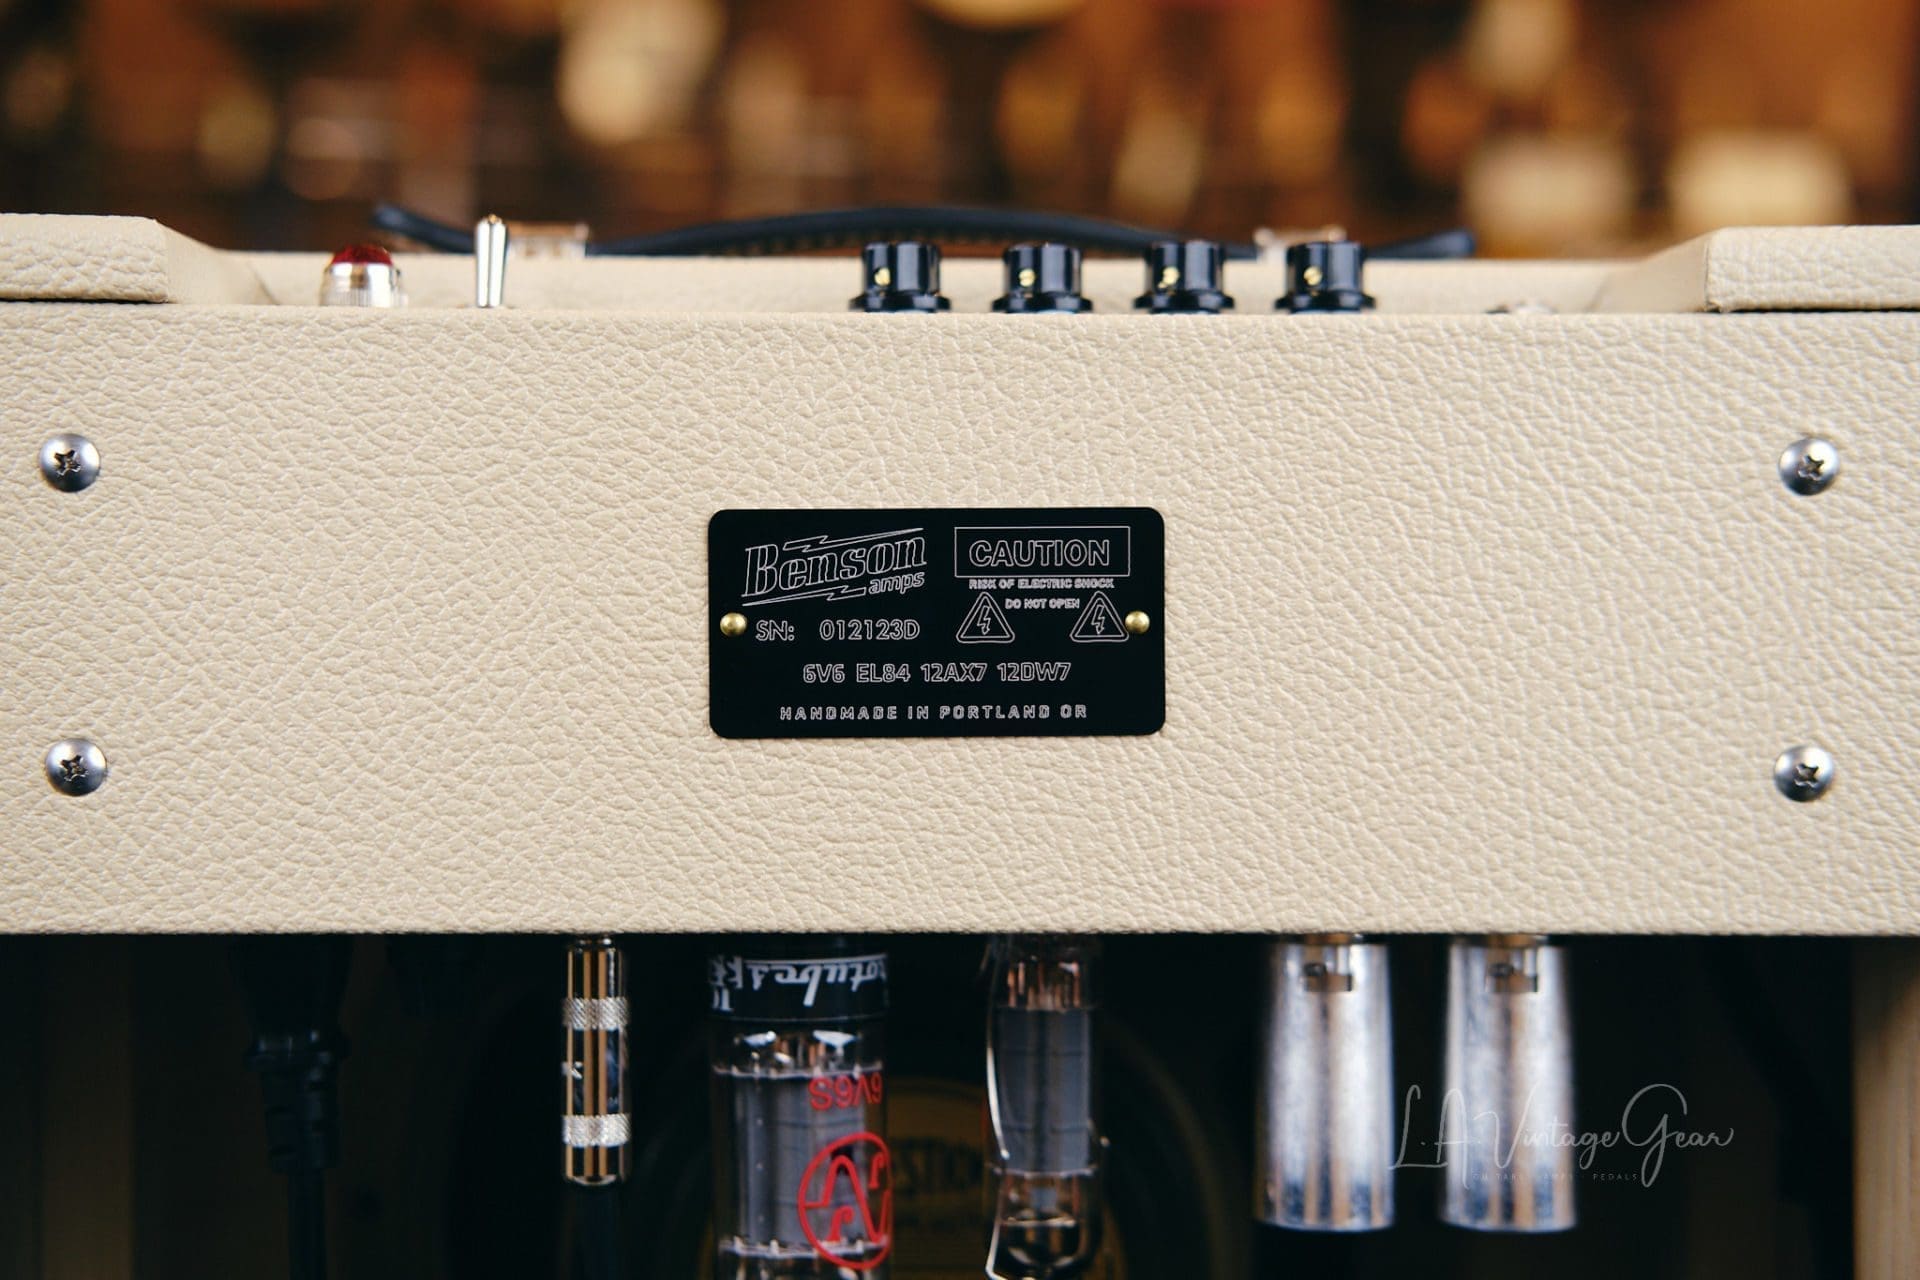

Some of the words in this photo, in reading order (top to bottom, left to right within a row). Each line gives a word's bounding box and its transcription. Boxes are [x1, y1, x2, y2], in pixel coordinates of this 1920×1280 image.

[968, 538, 1110, 567] CAUTION
[741, 536, 928, 598] Benson
[868, 571, 925, 595] amps
[968, 578, 997, 590] RISK
[999, 578, 1015, 590] OF
[1017, 578, 1073, 589] ELECTRIC
[1074, 577, 1115, 589] SHOCK
[1004, 598, 1021, 610] DO
[1023, 598, 1048, 610] NOT
[1049, 598, 1080, 609] OPEN
[755, 619, 796, 642] SN:
[818, 618, 921, 641] 012123D
[802, 663, 846, 684] 6V6
[855, 663, 912, 683] EL84
[919, 662, 988, 683] 12AX7
[996, 661, 1072, 682] 12DW7
[779, 706, 898, 721] HANDMADE
[907, 705, 929, 720] IN
[939, 704, 1050, 720] PORTLAND
[1060, 704, 1087, 719] OR
